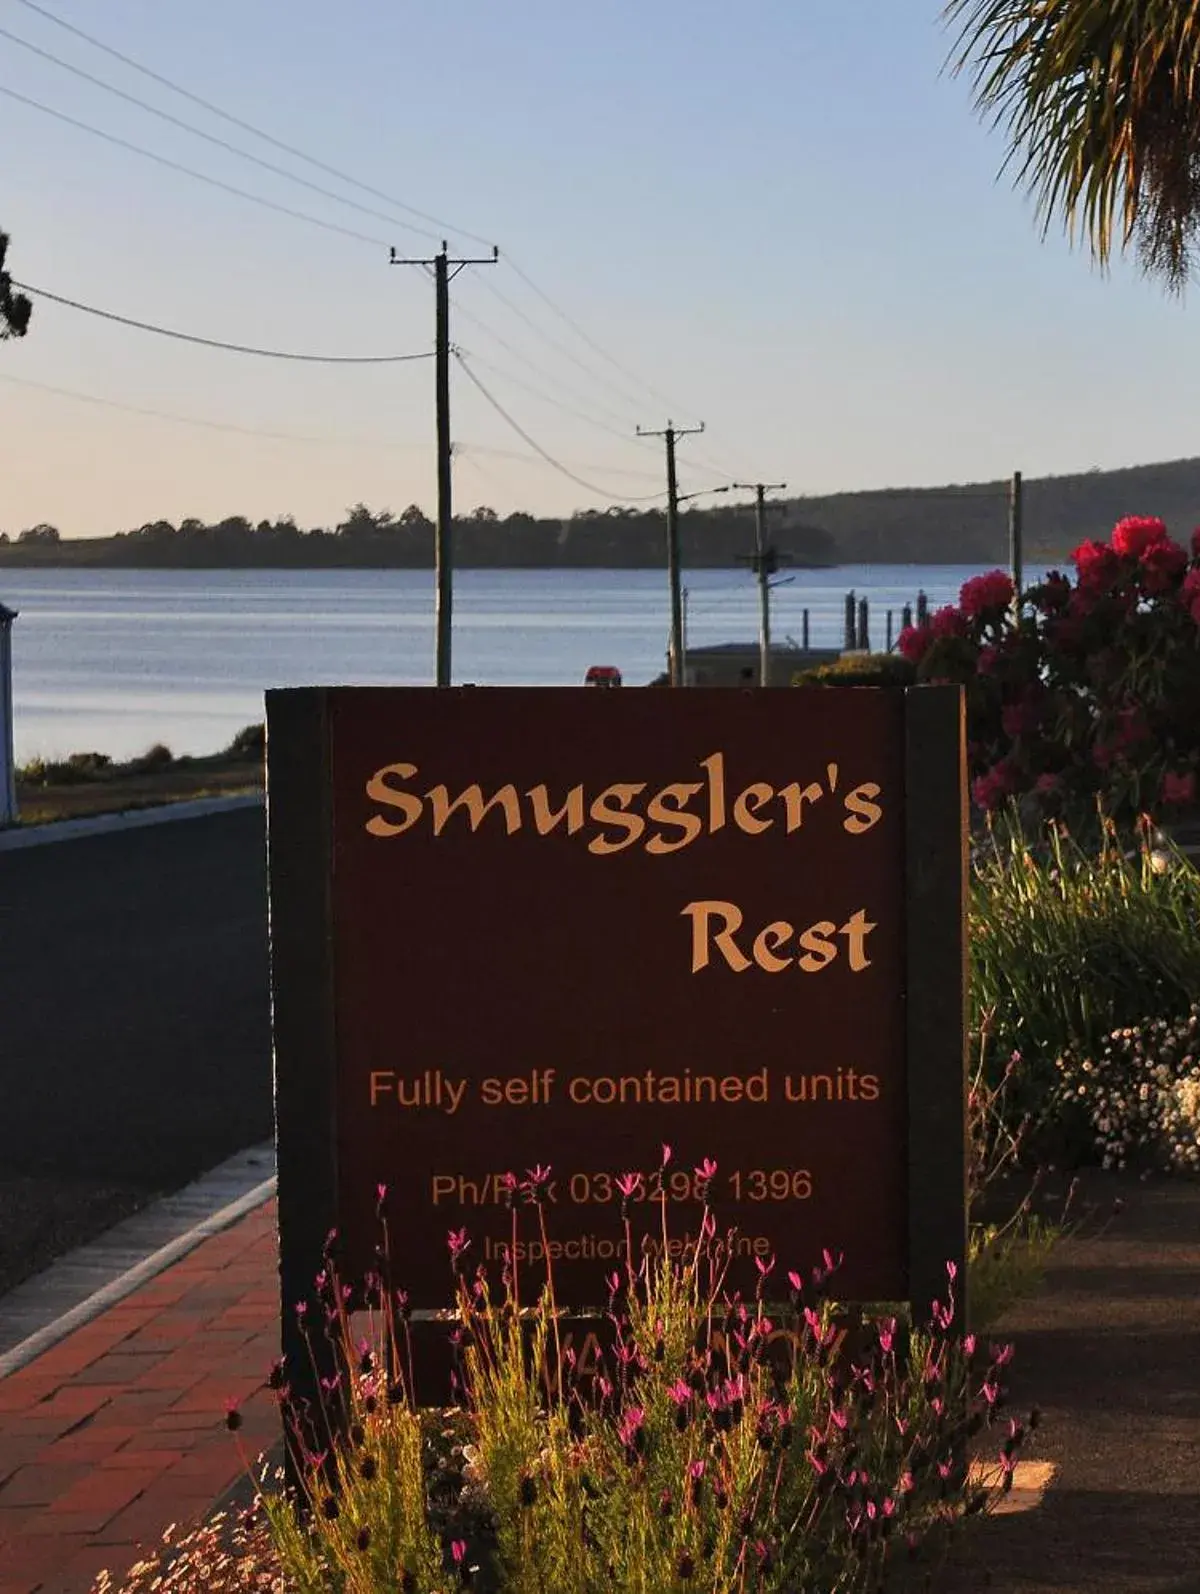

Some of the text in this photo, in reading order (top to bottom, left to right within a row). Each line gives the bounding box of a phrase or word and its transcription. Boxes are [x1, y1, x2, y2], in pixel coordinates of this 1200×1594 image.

[365, 751, 883, 855] Smuggler's
[680, 900, 878, 974] Rest
[368, 1066, 881, 1115] Fully self contained units
[431, 1173, 559, 1206] Ph/Fx
[570, 1172, 613, 1204] 03
[727, 1168, 813, 1201] 1396
